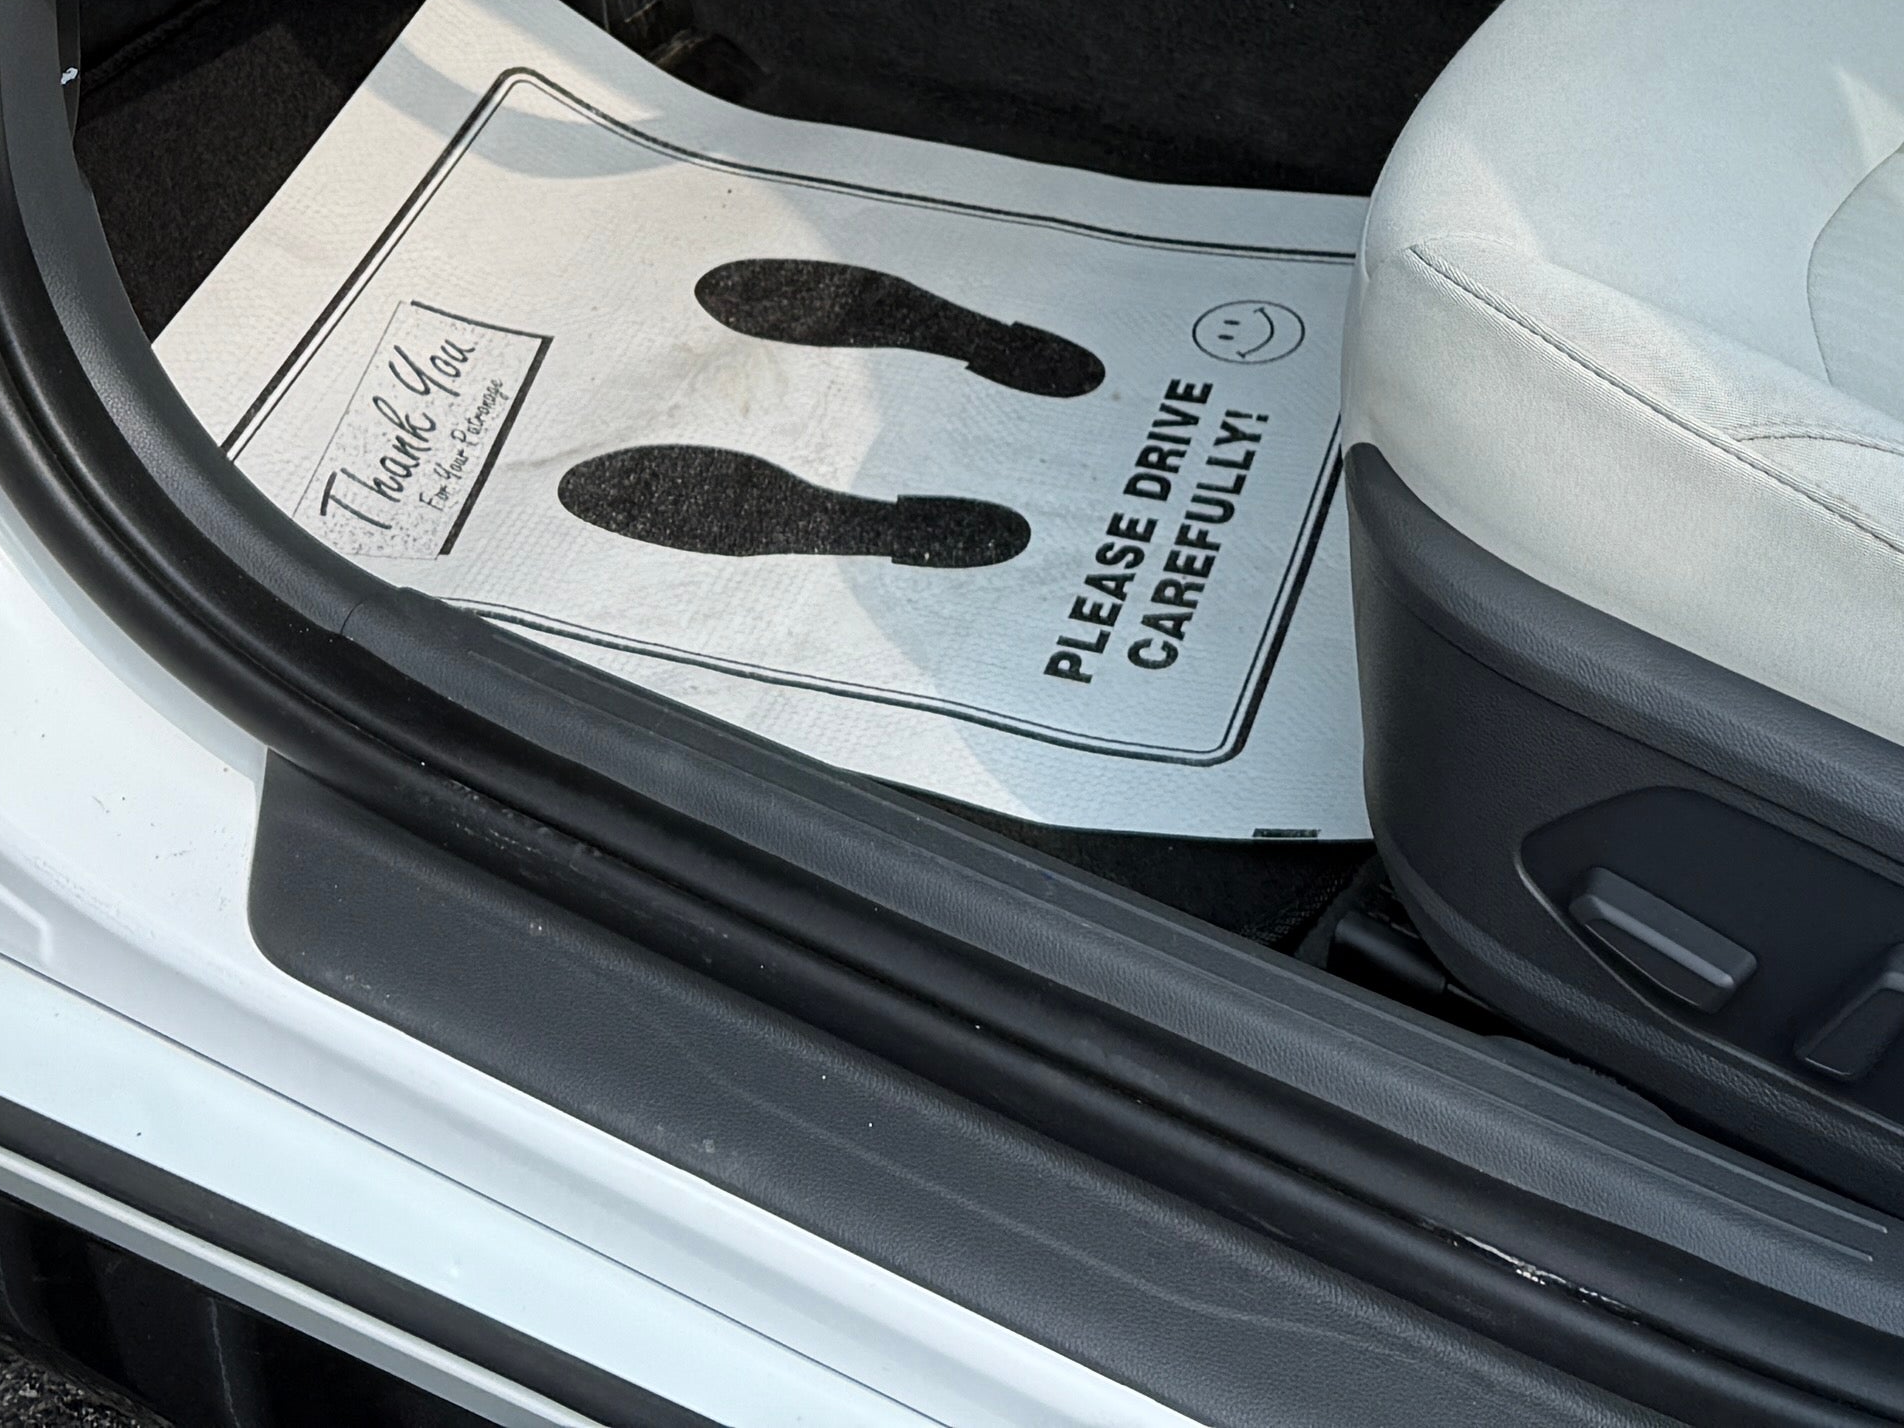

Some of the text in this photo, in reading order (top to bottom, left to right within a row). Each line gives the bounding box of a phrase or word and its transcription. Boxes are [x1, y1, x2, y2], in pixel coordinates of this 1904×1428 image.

[319, 338, 476, 530] Thank You
[419, 377, 510, 512] For Your Patronage
[1043, 378, 1214, 684] PLEASE DRIVE
[1127, 409, 1269, 670] CAREFULLY!
